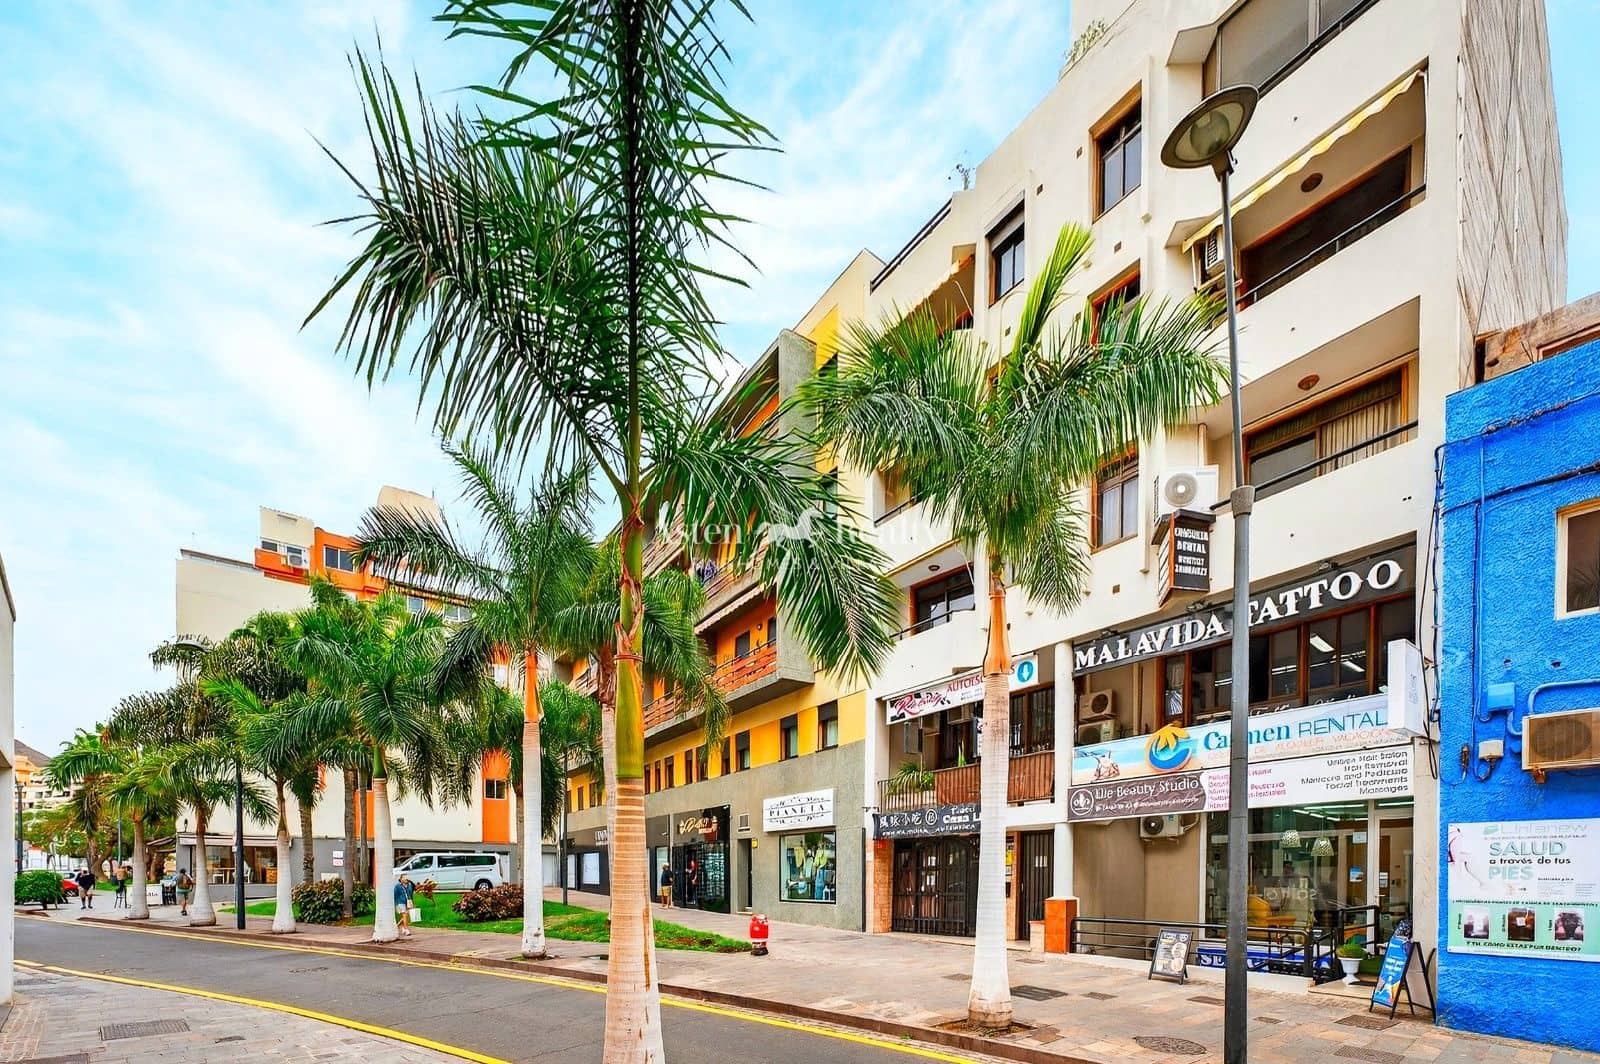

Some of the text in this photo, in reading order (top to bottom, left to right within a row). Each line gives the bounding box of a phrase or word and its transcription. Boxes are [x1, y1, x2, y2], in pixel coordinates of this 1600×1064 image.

[1074, 613, 1231, 671] MALAVIDA
[1203, 723, 1291, 751] Camen
[1299, 711, 1388, 736] RENTAL
[1116, 782, 1156, 798] Beauty
[1159, 777, 1199, 792] Studio
[1489, 840, 1567, 856] SALUD
[1488, 866, 1535, 880] PIES
